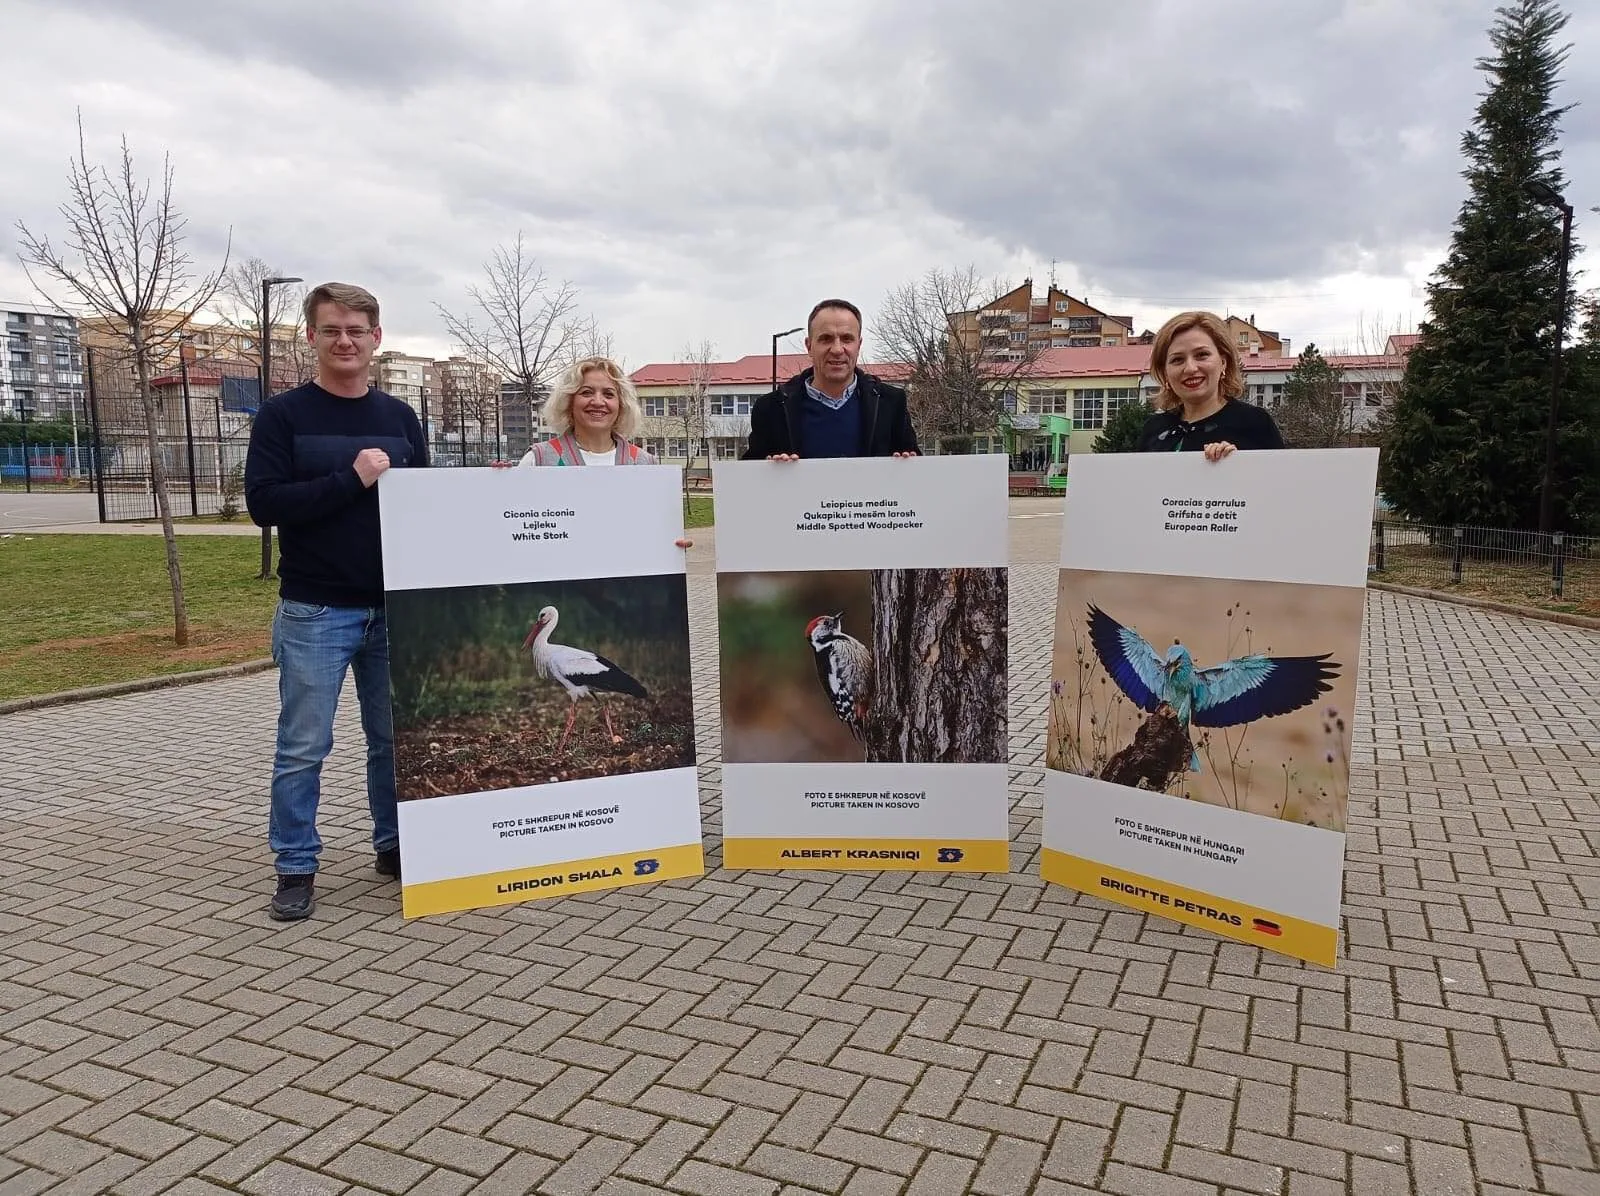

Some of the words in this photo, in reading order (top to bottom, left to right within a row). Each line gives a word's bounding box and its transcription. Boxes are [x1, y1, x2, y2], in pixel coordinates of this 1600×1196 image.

[820, 500, 863, 510] Leiopicus
[865, 499, 898, 508] medius
[1162, 498, 1203, 507] Coracias
[1205, 499, 1246, 509] garrulus
[503, 509, 539, 519] Ciconia
[541, 508, 575, 518] ciconia
[803, 511, 847, 521] Qukapiku
[848, 511, 852, 519] i
[1167, 510, 1203, 519] Grifsha
[1212, 511, 1238, 520] detit
[523, 520, 557, 530] Lejleku
[796, 523, 826, 531] Middle
[828, 522, 865, 532] Spotted
[867, 520, 924, 531] Woodpecker
[1164, 522, 1208, 533] European
[1210, 523, 1238, 532] Roller
[512, 532, 541, 541] White
[543, 531, 569, 540] Stork
[879, 790, 891, 799] NË
[892, 791, 926, 800] KOSOVË
[811, 801, 845, 809] PICTURE
[847, 801, 874, 809] TAKEN
[875, 801, 884, 809] IN
[885, 801, 920, 809] KOSOVO
[492, 819, 516, 830] FOTO
[525, 812, 571, 825] SHKREPUR
[572, 809, 584, 819] NË
[585, 805, 620, 817] KOSOVË
[500, 827, 537, 838] PICTURE
[538, 823, 566, 833] TAKEN
[568, 821, 577, 829] IN
[578, 817, 614, 828] KOSOVO
[1114, 817, 1136, 828] FOTO
[1137, 822, 1143, 830] E
[1144, 824, 1188, 841] SHKREPUR
[1189, 835, 1202, 845] NË
[1203, 839, 1245, 856] HUNGARI
[1119, 828, 1153, 843] PICTURE
[1154, 837, 1182, 851] TAKEN
[1183, 844, 1192, 853] IN
[1193, 847, 1238, 864] HUNGARY
[780, 849, 842, 858] ALBERT
[846, 850, 920, 860] KRASNIQI
[497, 875, 563, 893] LIRIDON
[568, 867, 622, 883] SHALA
[1100, 876, 1170, 905] BRIGITTE
[1174, 898, 1242, 926] PETRAS
